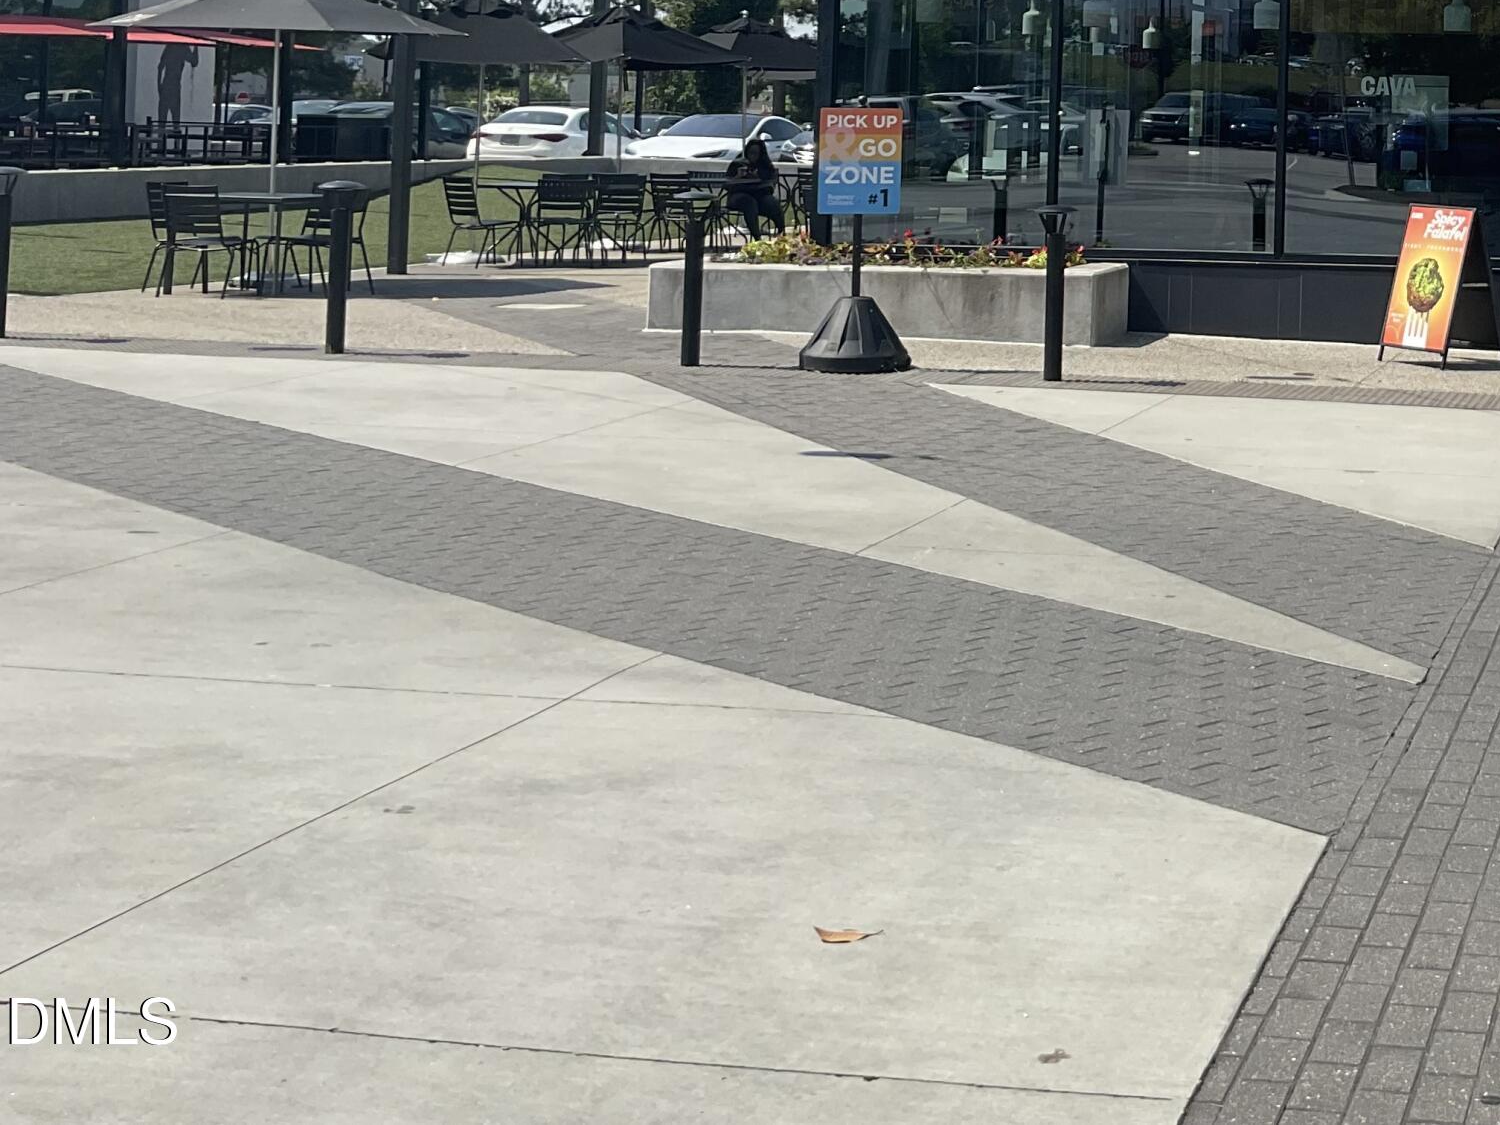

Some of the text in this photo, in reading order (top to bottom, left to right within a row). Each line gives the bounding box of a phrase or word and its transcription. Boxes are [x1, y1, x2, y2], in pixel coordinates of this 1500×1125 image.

[1361, 75, 1417, 96] CAVA
[826, 114, 898, 129] PICK UP
[858, 138, 897, 157] GO
[824, 166, 895, 185] ZONE
[867, 188, 889, 207] #1
[1431, 209, 1467, 227] Spicy
